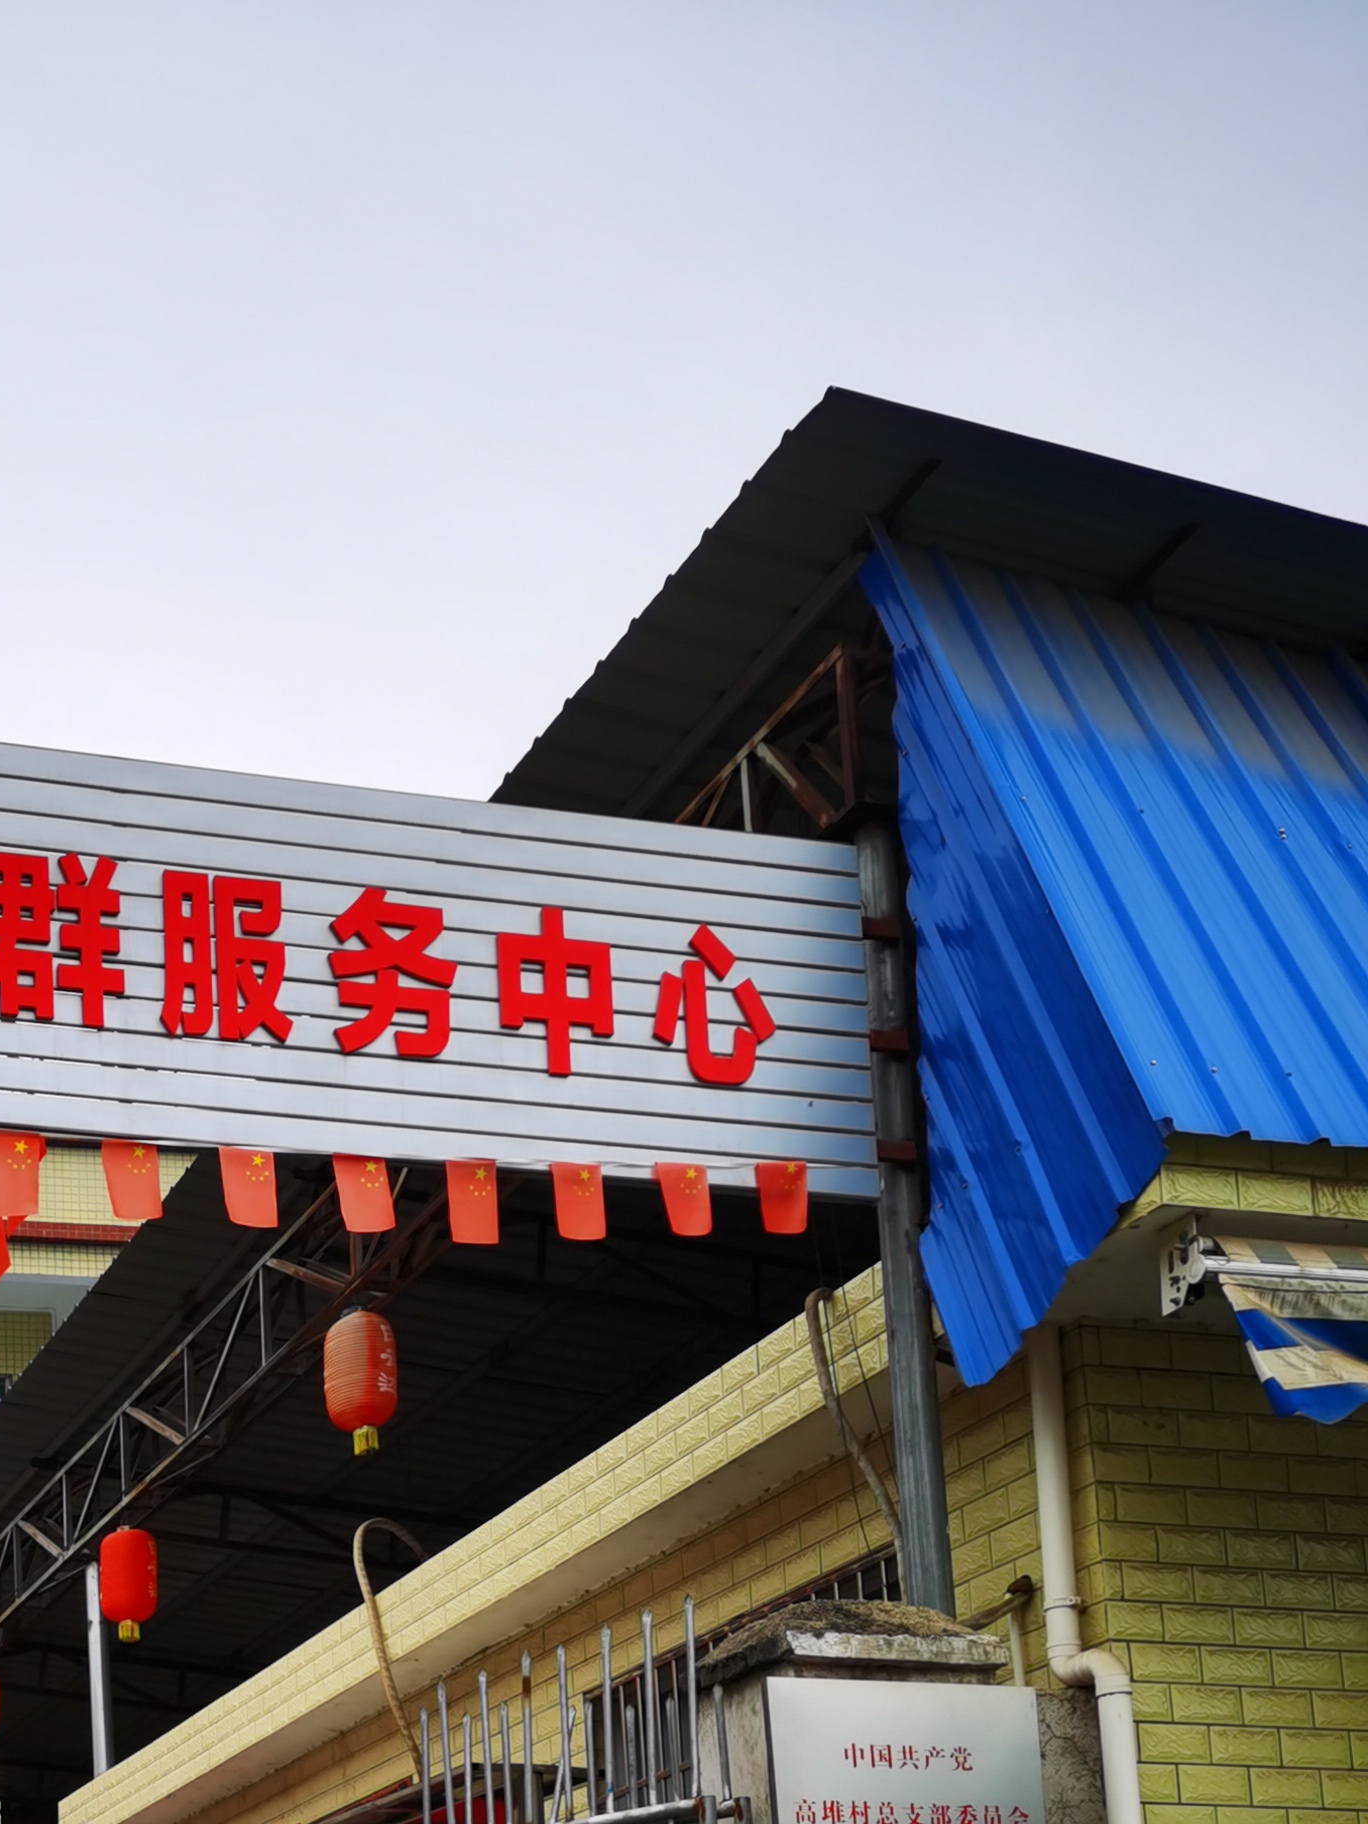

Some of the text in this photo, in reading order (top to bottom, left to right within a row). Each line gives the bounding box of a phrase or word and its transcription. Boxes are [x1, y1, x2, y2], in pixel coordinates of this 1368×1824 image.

[843, 1743, 974, 1772] 中国共产党
